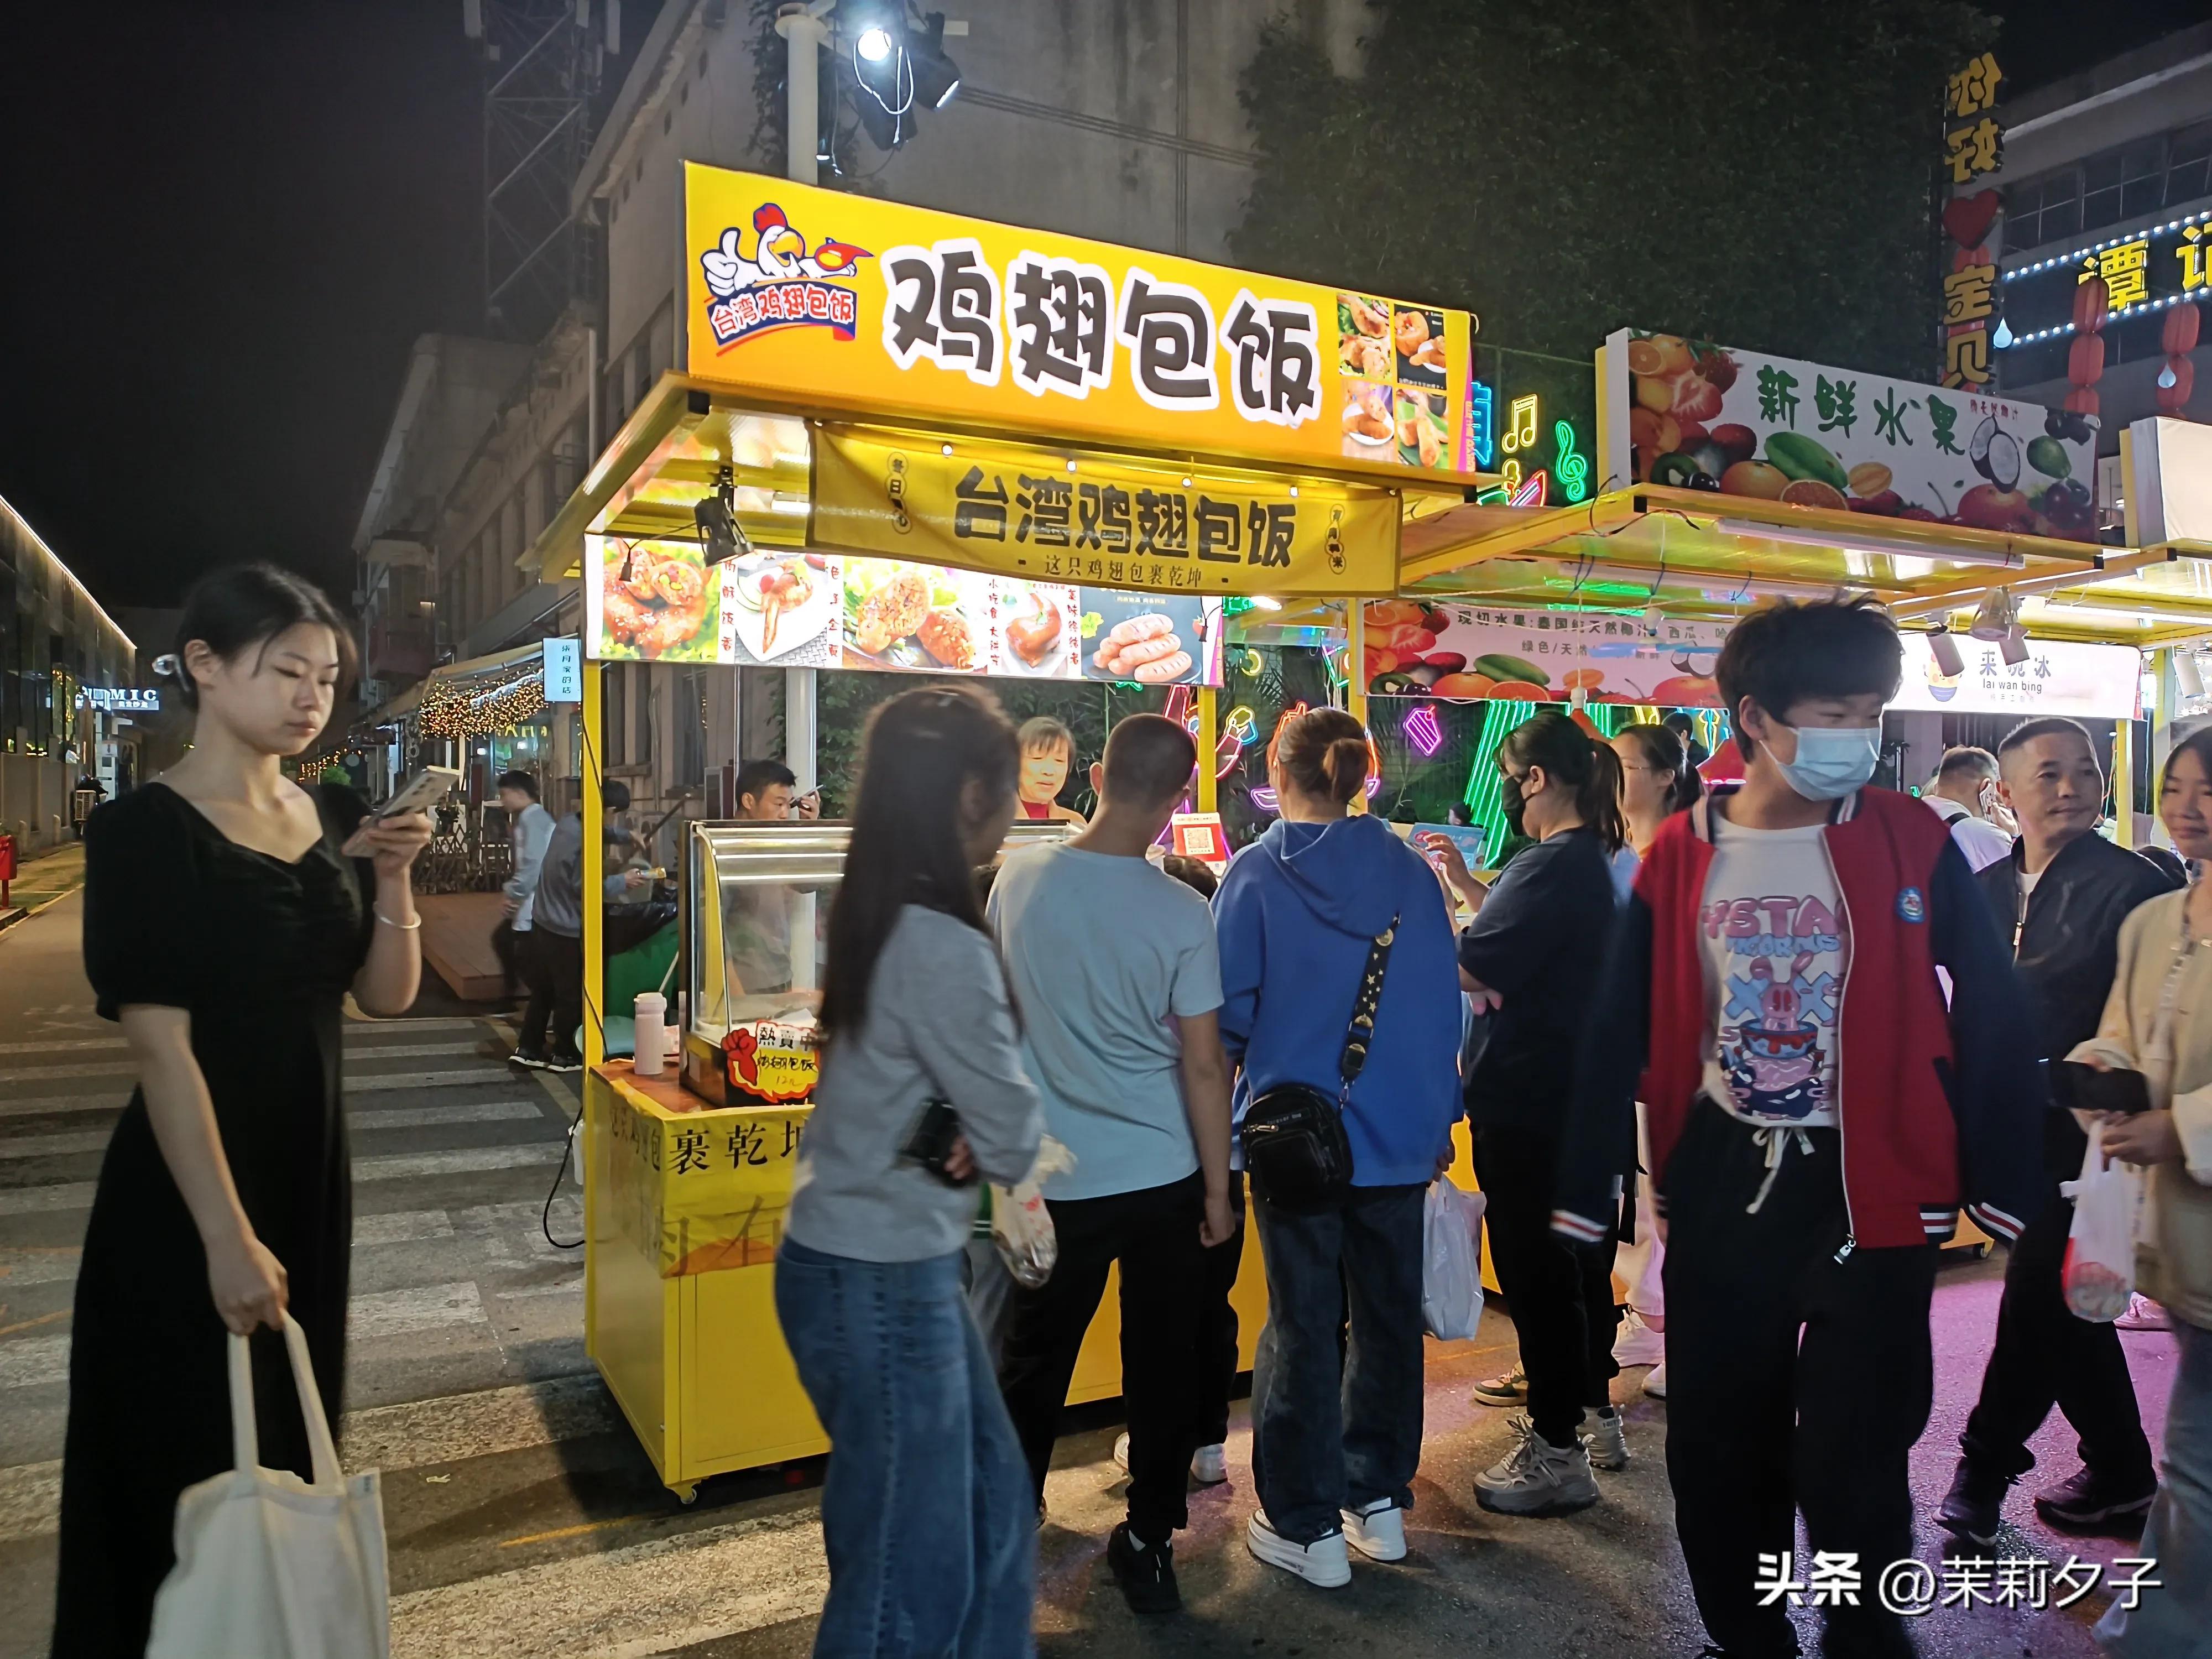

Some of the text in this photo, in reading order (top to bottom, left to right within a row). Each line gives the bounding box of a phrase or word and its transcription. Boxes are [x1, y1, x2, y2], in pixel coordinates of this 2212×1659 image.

[712, 285, 854, 337] 台湾鸡翅包饭
[887, 247, 1318, 420] 鸡翅包饭
[1756, 363, 1965, 457] 新鲜水果
[954, 465, 1297, 568] 台湾鸡翅包饭
[1044, 554, 1203, 587] 这只鸡翅包裹乾坤
[1999, 681, 2017, 690] wan
[2021, 680, 2042, 695] bing
